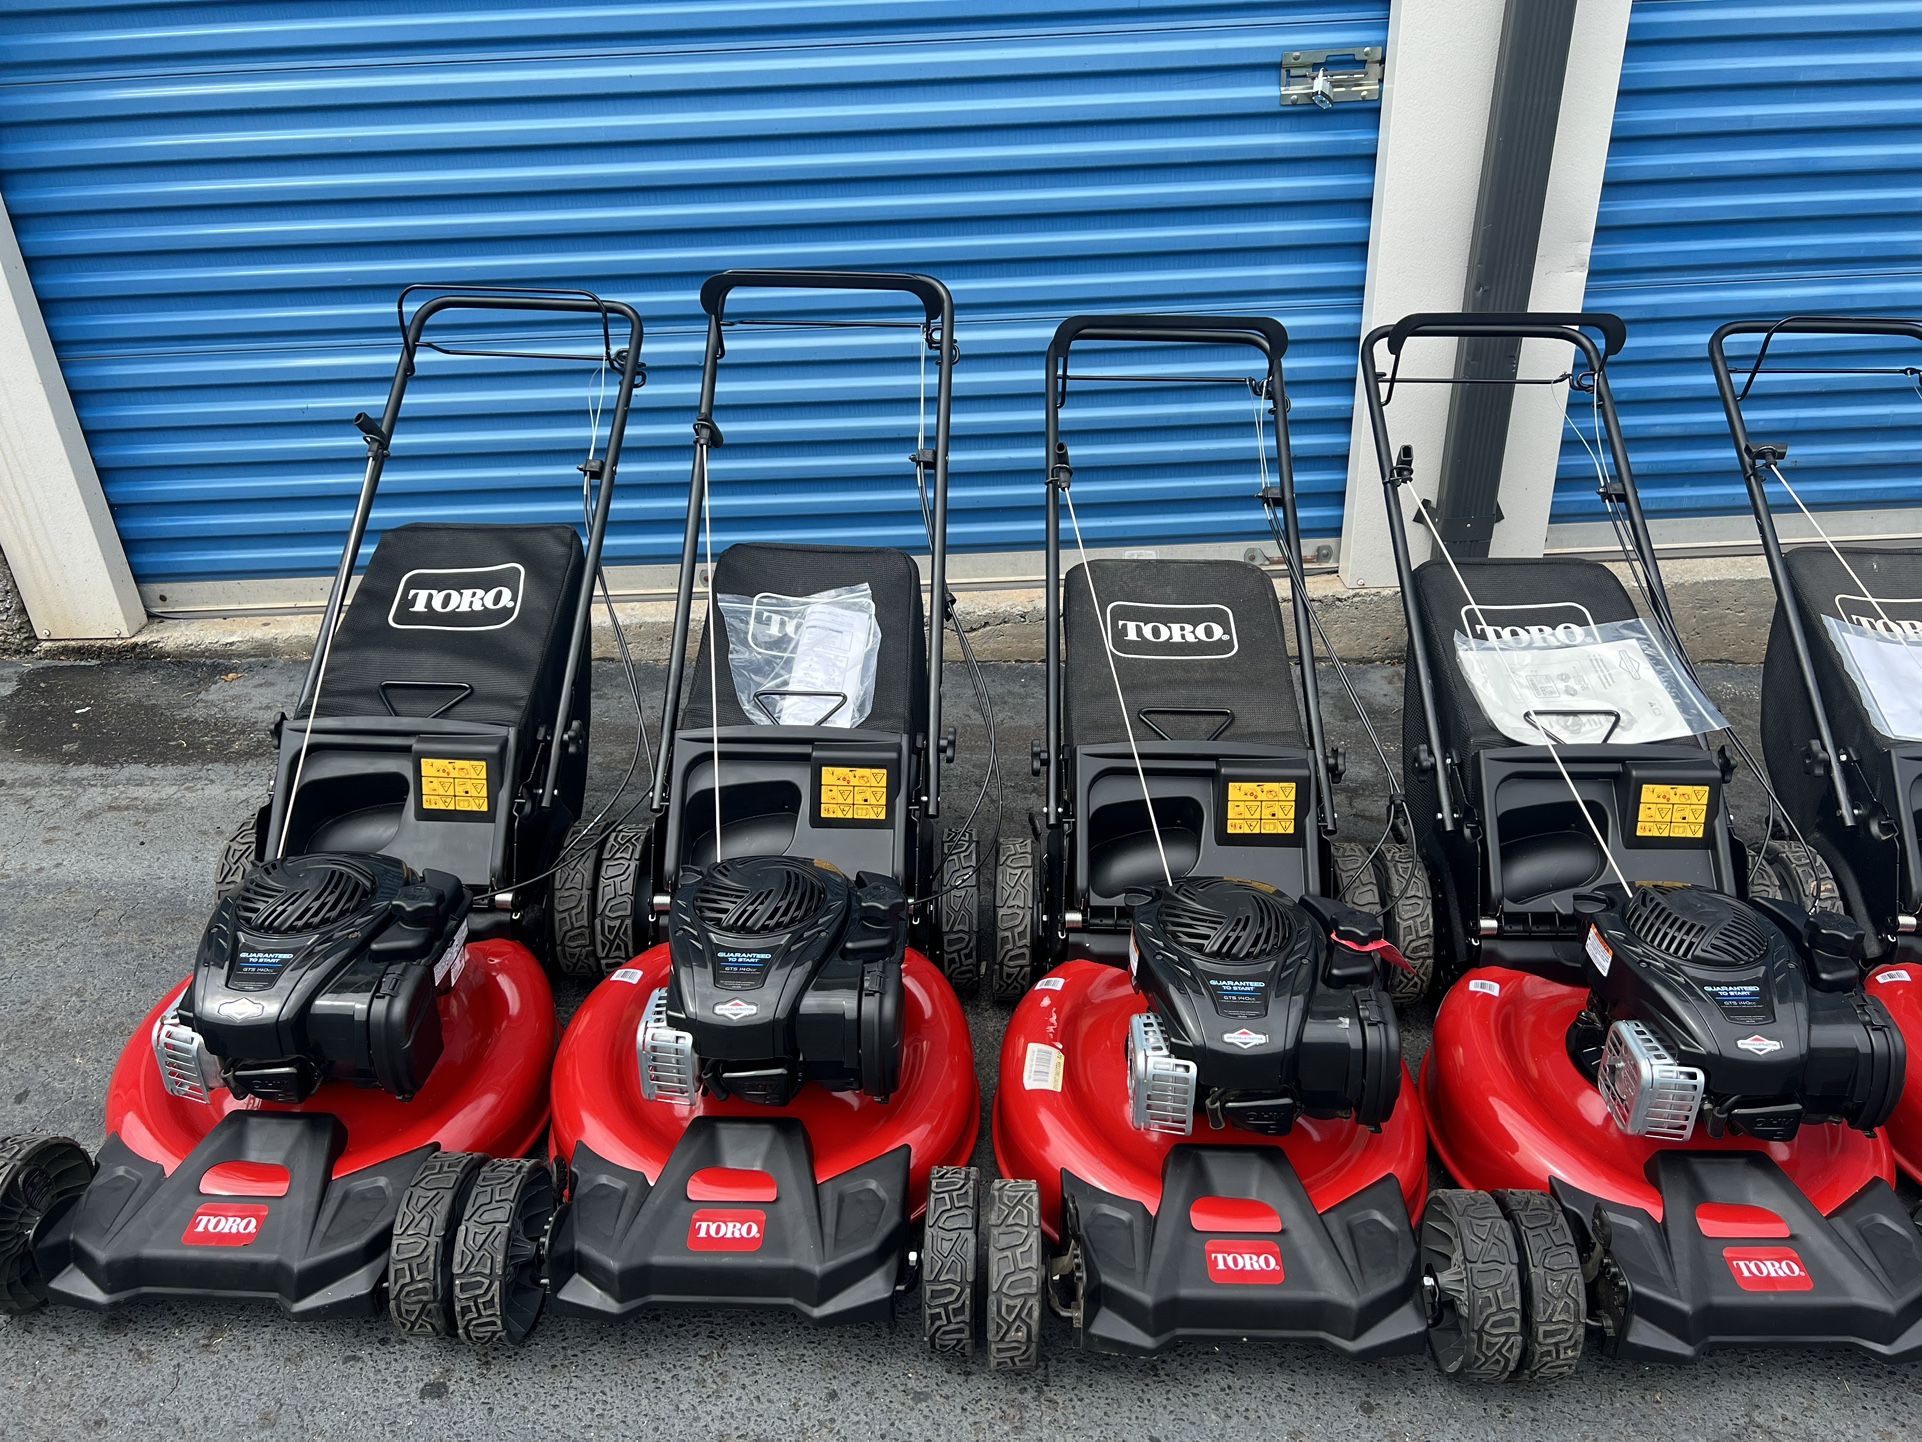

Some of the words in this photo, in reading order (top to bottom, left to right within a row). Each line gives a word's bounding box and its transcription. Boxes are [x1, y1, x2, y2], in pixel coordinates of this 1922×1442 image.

[408, 586, 513, 612] TORO
[762, 611, 805, 638] TO
[1118, 620, 1225, 642] TORO
[1475, 623, 1586, 647] TORO
[1851, 614, 1922, 642] TOR
[194, 1215, 257, 1233] TORO
[695, 1222, 759, 1238] TORO
[1211, 1253, 1277, 1270] TORO
[1732, 1260, 1802, 1277] TORO
